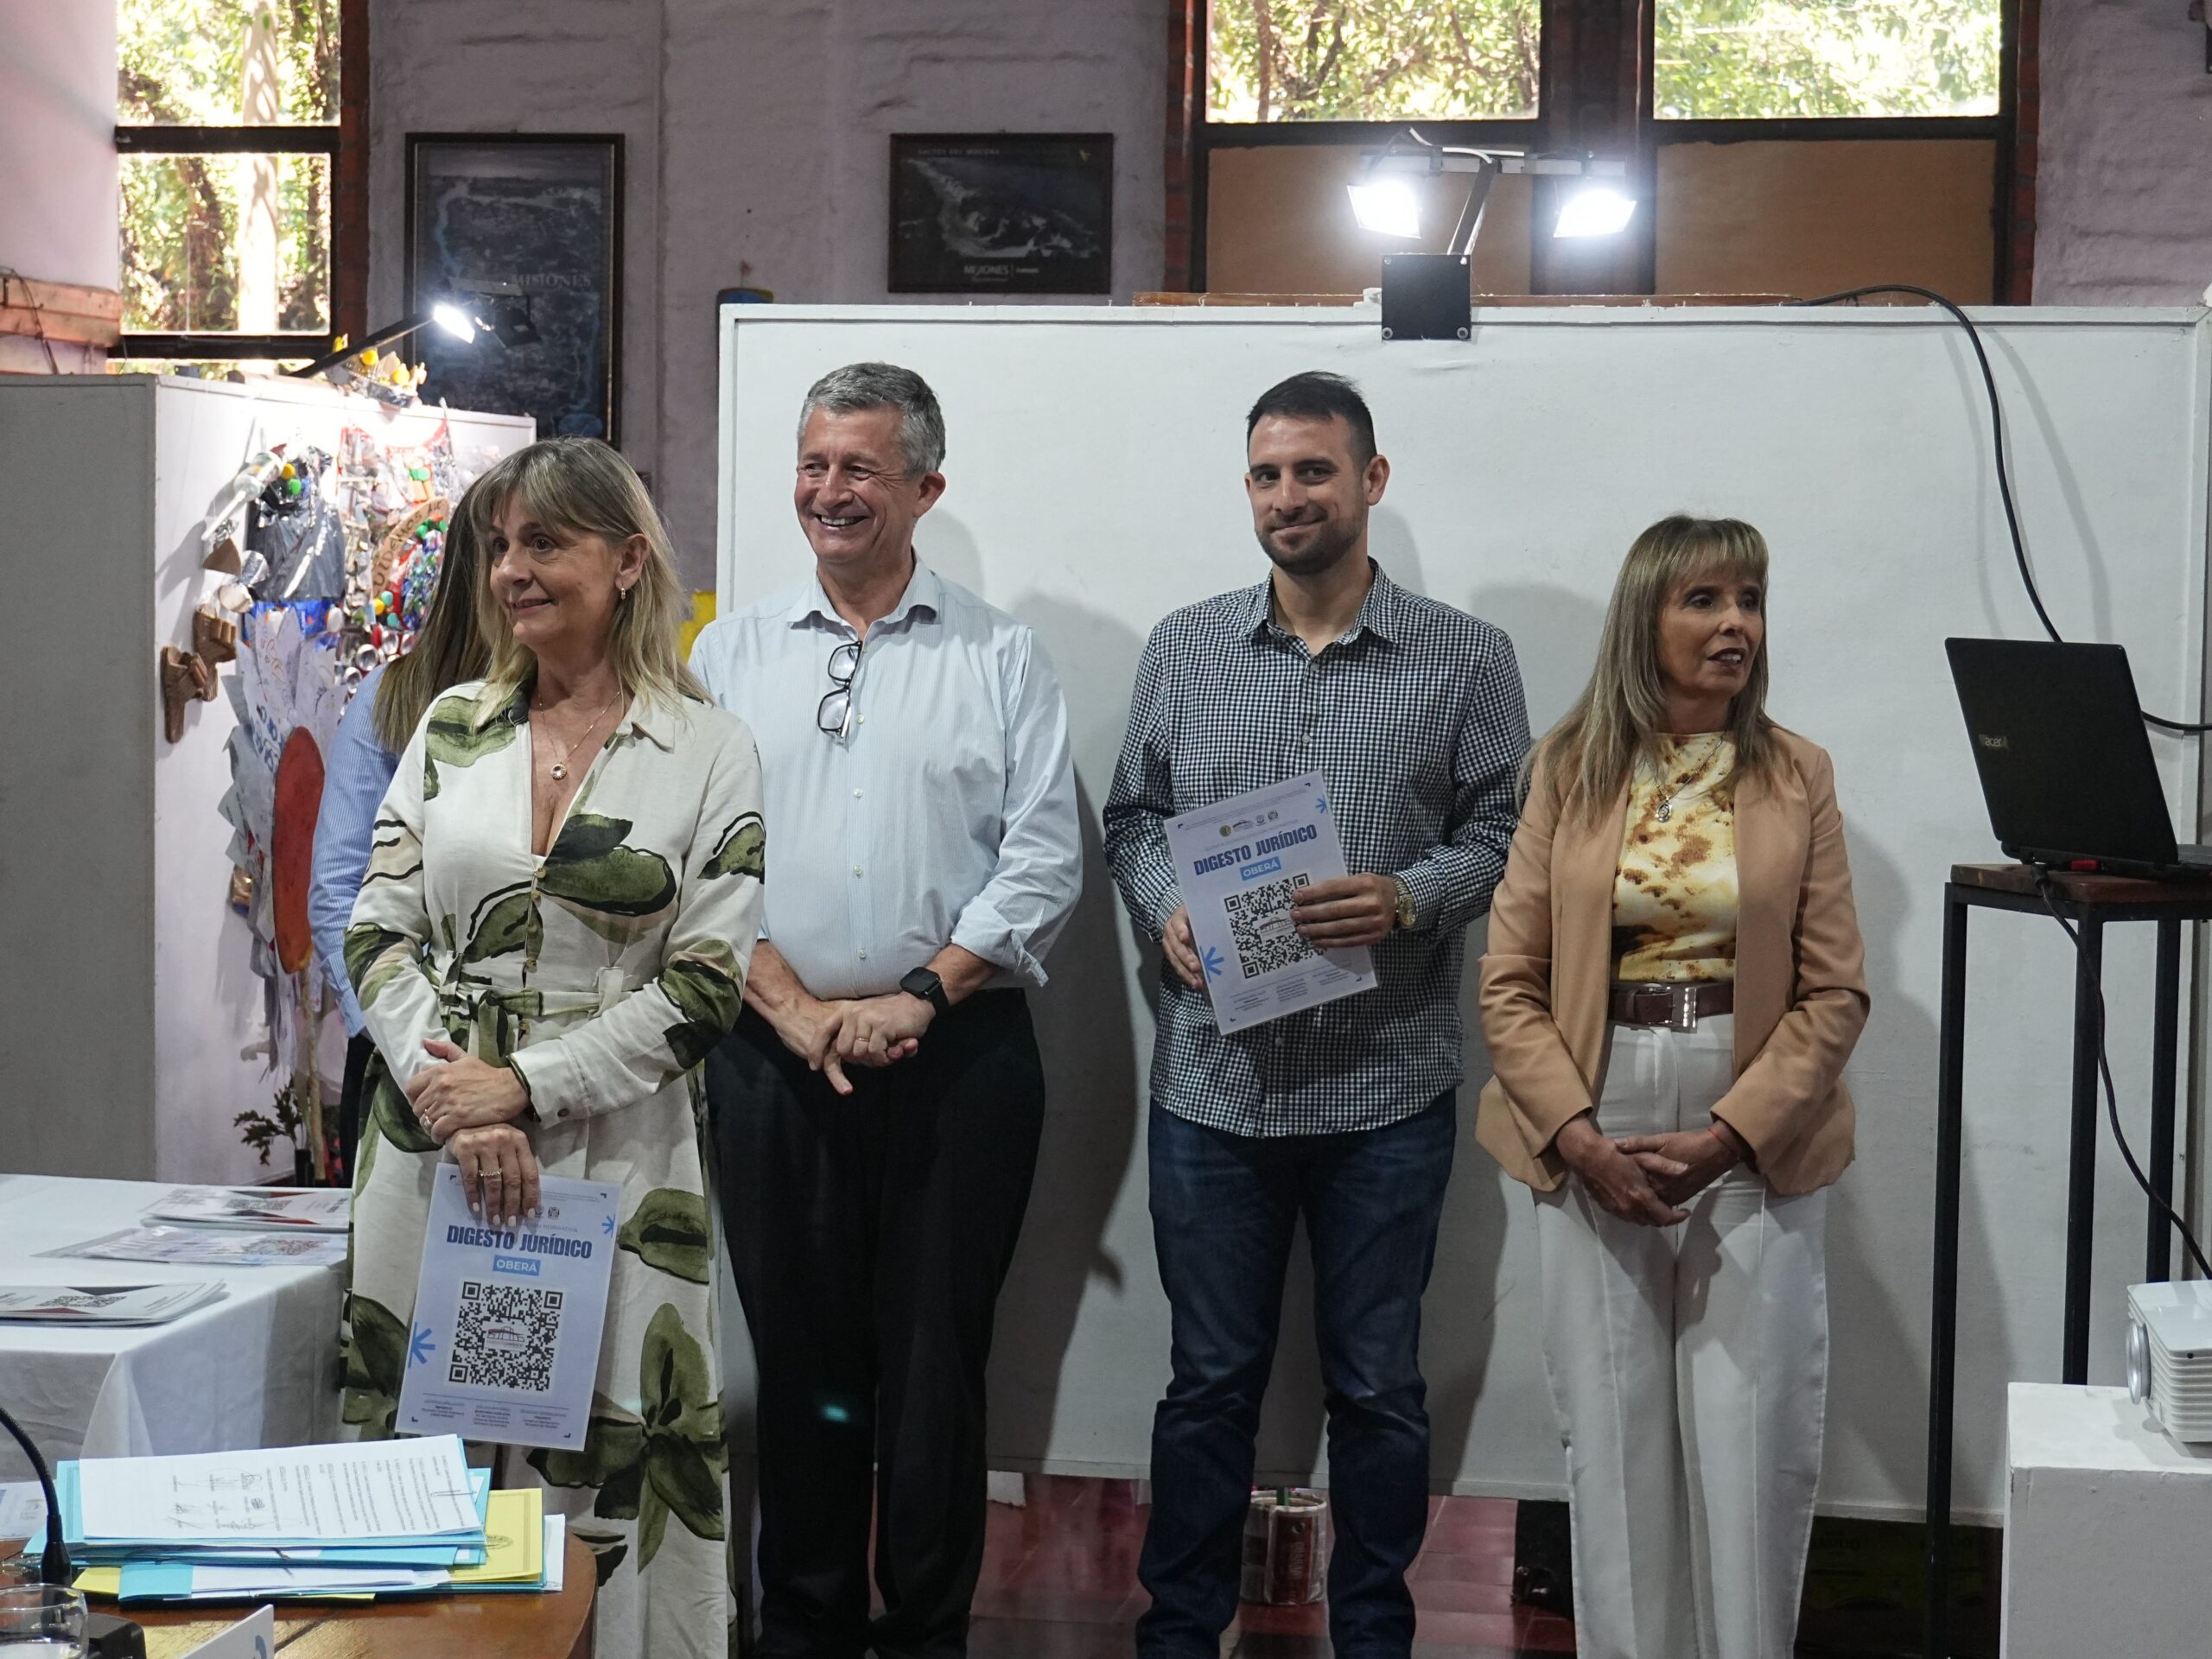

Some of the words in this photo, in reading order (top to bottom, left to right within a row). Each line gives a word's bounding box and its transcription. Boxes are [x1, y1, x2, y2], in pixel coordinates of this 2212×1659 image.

[512, 273, 592, 287] MISIONES
[1985, 737, 2002, 747] acer
[1193, 844, 1251, 876] DIGESTO
[1256, 823, 1318, 856] JURÍDICO
[1243, 859, 1279, 877] OBERÁ
[447, 1224, 515, 1249] DIGESTO
[519, 1233, 593, 1259] JURÍDICO
